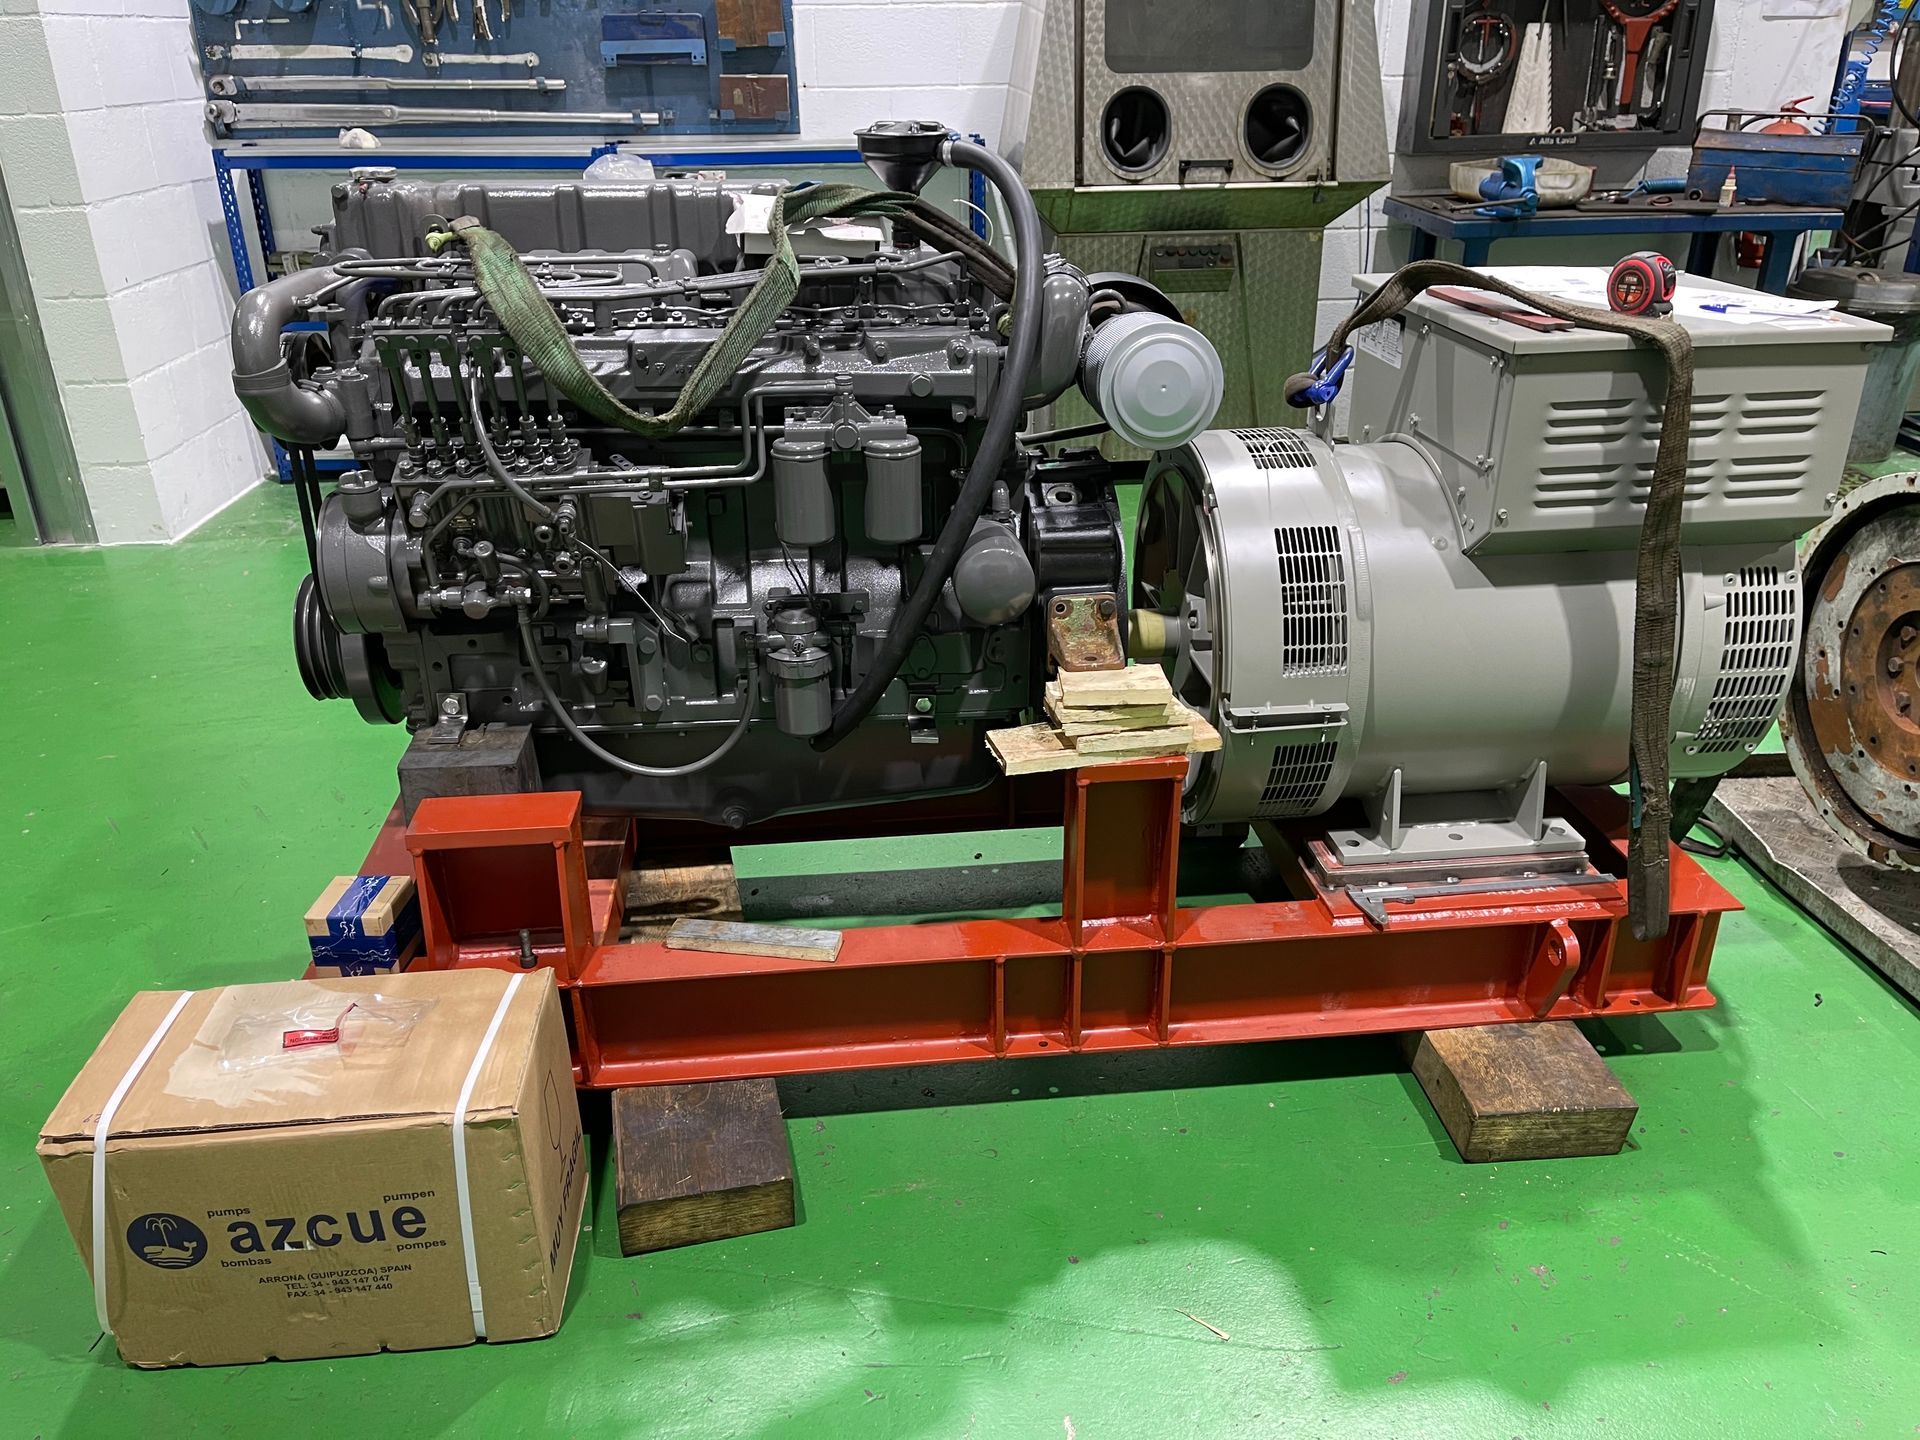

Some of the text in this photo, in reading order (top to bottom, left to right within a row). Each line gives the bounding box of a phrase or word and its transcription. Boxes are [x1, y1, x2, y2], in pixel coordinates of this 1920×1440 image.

[383, 1190, 435, 1204] pumpen
[207, 1207, 251, 1219] pumps
[227, 1205, 427, 1254] azcue
[396, 1238, 447, 1252] pompes
[550, 1203, 564, 1274] MUY
[220, 1257, 272, 1268] bombas
[258, 1264, 412, 1284] ARRONA (GUIPUZCOA) SPAIN
[285, 1281, 309, 1291] TEL:
[310, 1281, 324, 1289] 34
[332, 1277, 350, 1286] 943
[353, 1276, 369, 1285] 147
[372, 1274, 390, 1283] 047
[287, 1289, 311, 1299] FAX:
[314, 1288, 326, 1297] 34
[334, 1286, 352, 1294] 943
[355, 1284, 372, 1293] 147
[375, 1282, 393, 1291] 440
